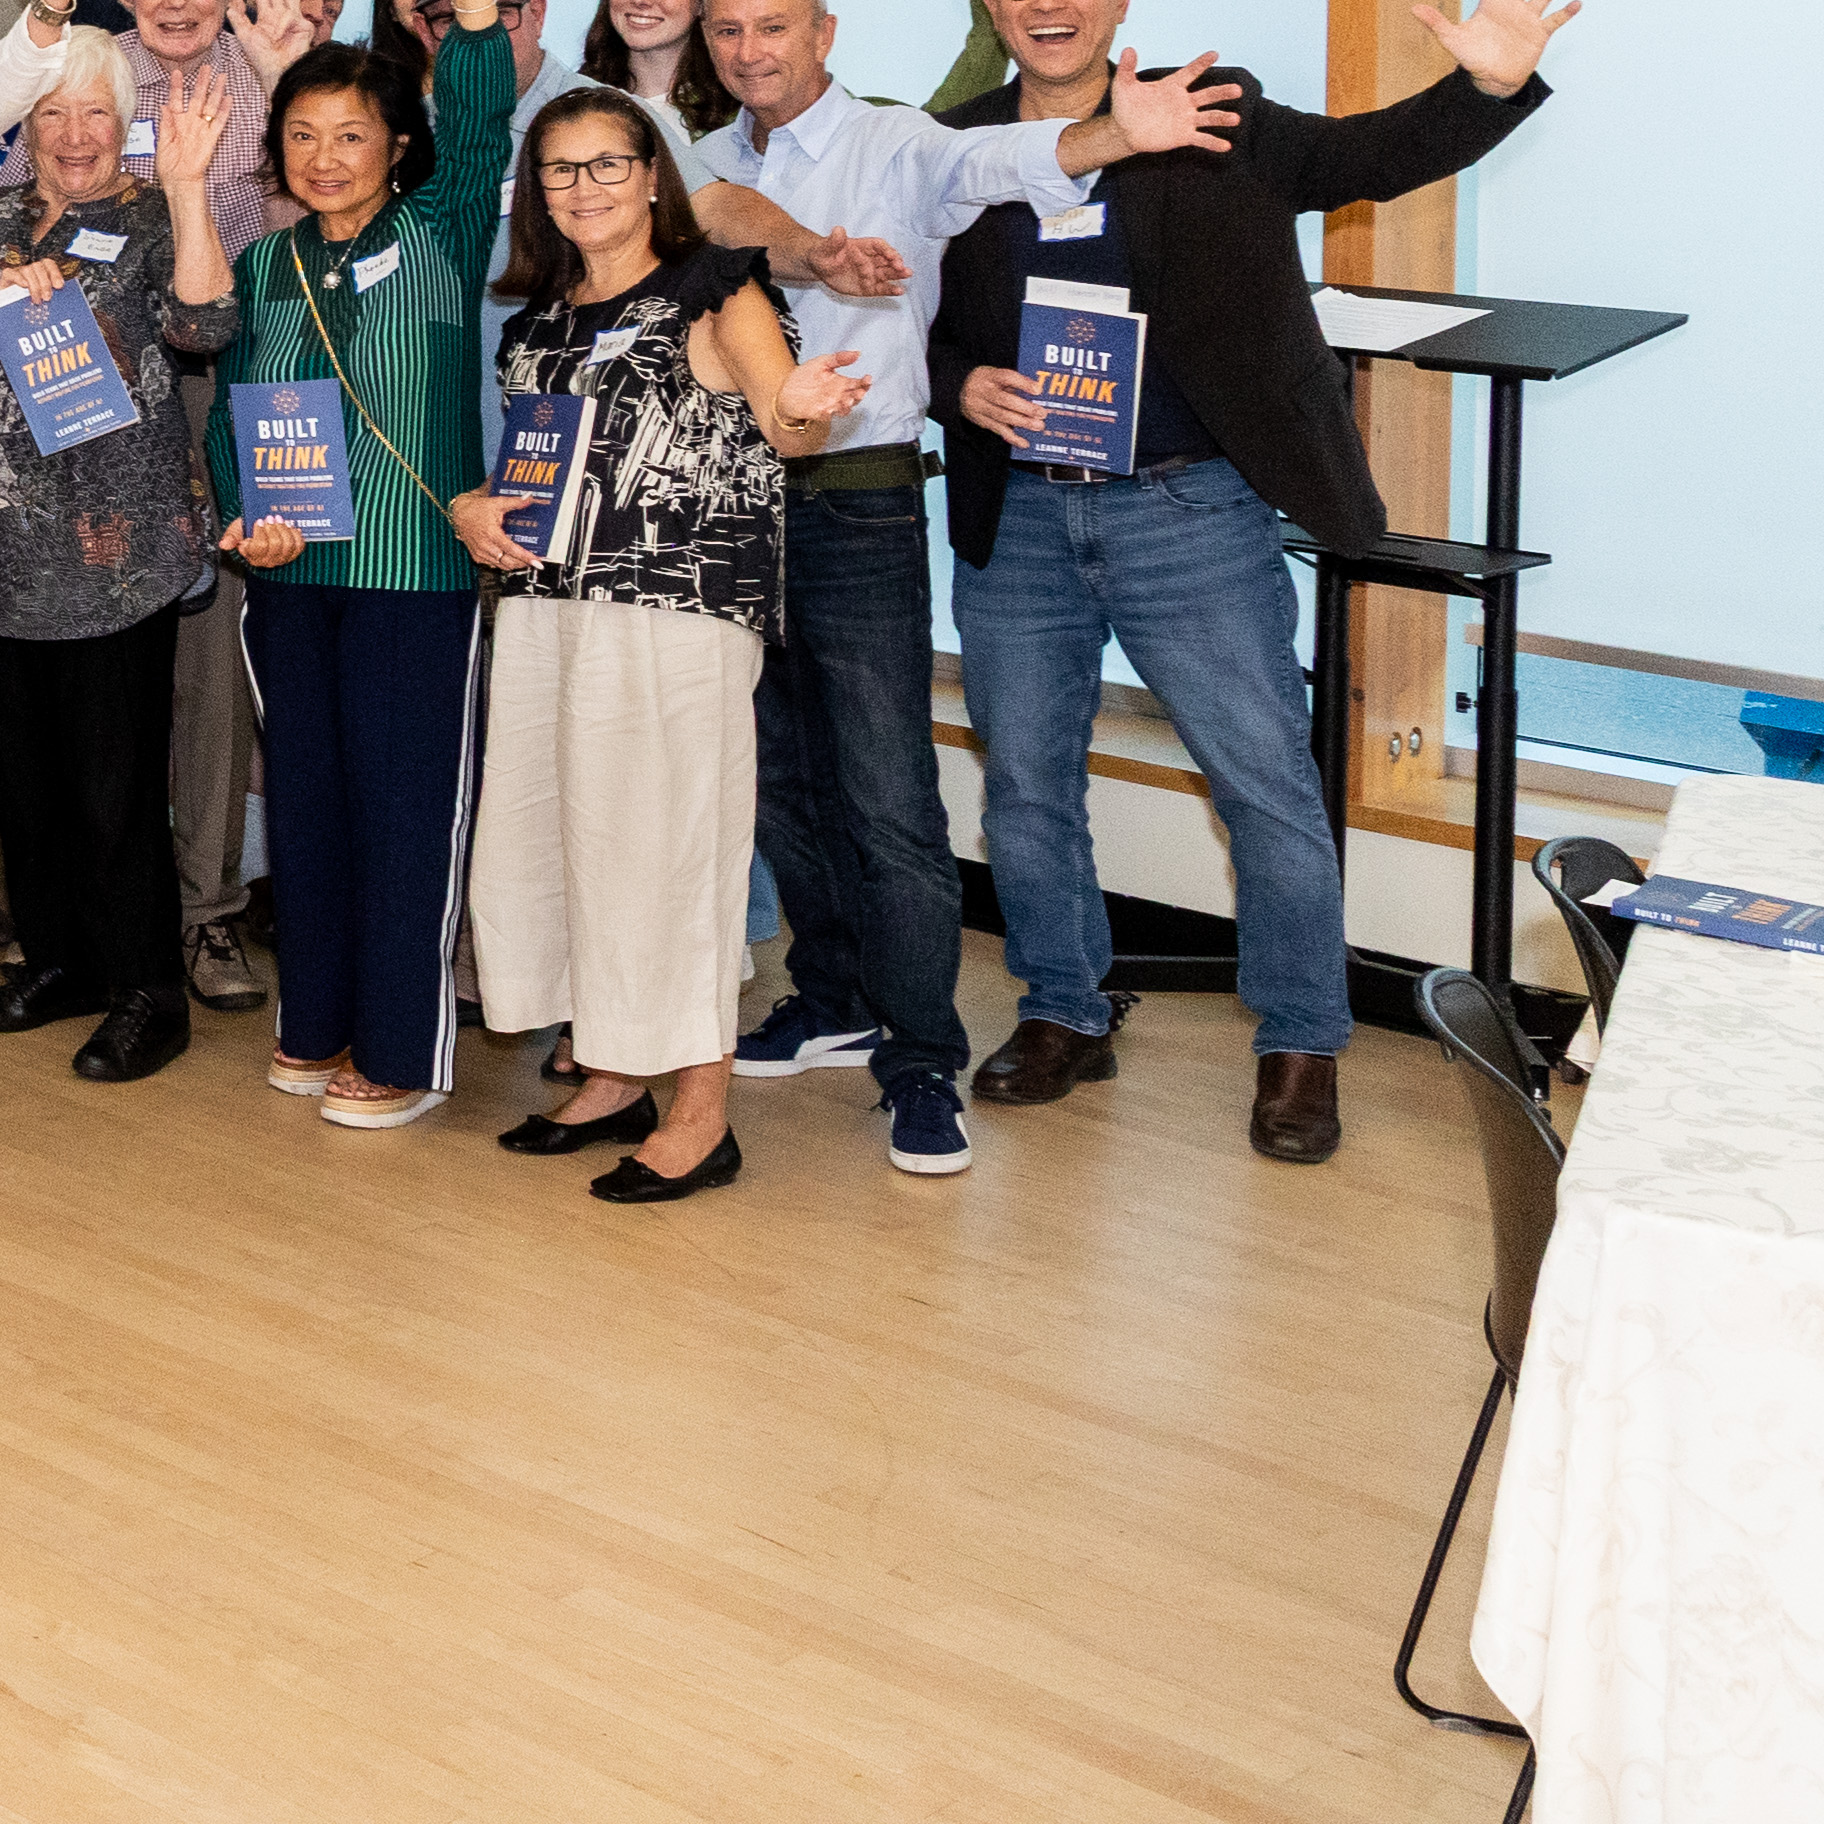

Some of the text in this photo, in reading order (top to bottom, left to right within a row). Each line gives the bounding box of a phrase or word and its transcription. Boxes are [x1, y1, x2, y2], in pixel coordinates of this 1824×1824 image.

[18, 318, 76, 357] BUILT
[21, 341, 94, 387] THINK
[1044, 344, 1112, 372] BUILT
[1035, 370, 1118, 404] THINK
[83, 408, 116, 426] TERRACE
[257, 417, 320, 439] BUILT
[515, 431, 562, 453] BUILT
[252, 445, 333, 470] THINK
[503, 459, 562, 485] THINK
